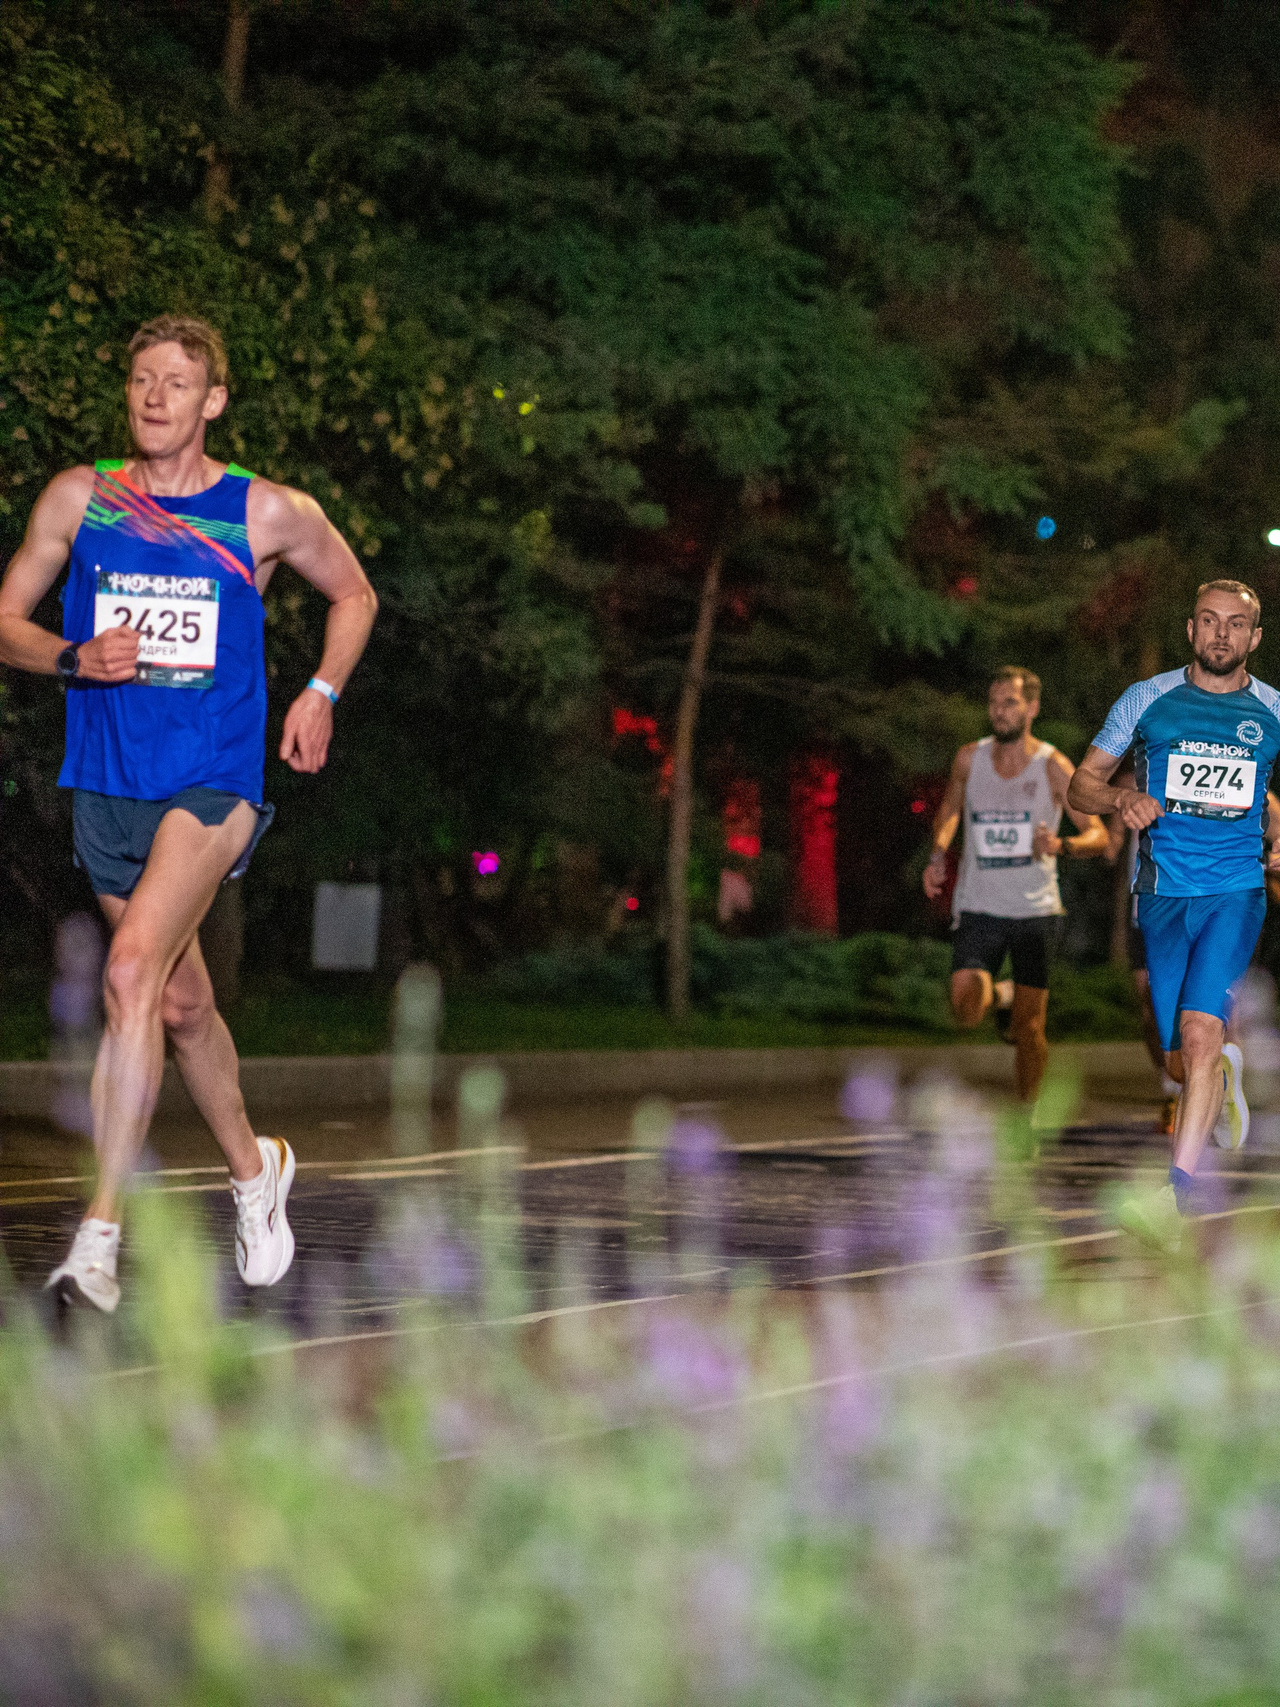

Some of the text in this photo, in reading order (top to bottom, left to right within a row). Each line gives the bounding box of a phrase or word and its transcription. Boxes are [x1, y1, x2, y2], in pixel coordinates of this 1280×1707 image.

[114, 606, 201, 644] 2425
[139, 644, 178, 656] НДРЕЙ
[1180, 763, 1244, 791] 9274
[1194, 790, 1226, 799] СЕРГЕЙ
[985, 829, 1018, 847] 840
